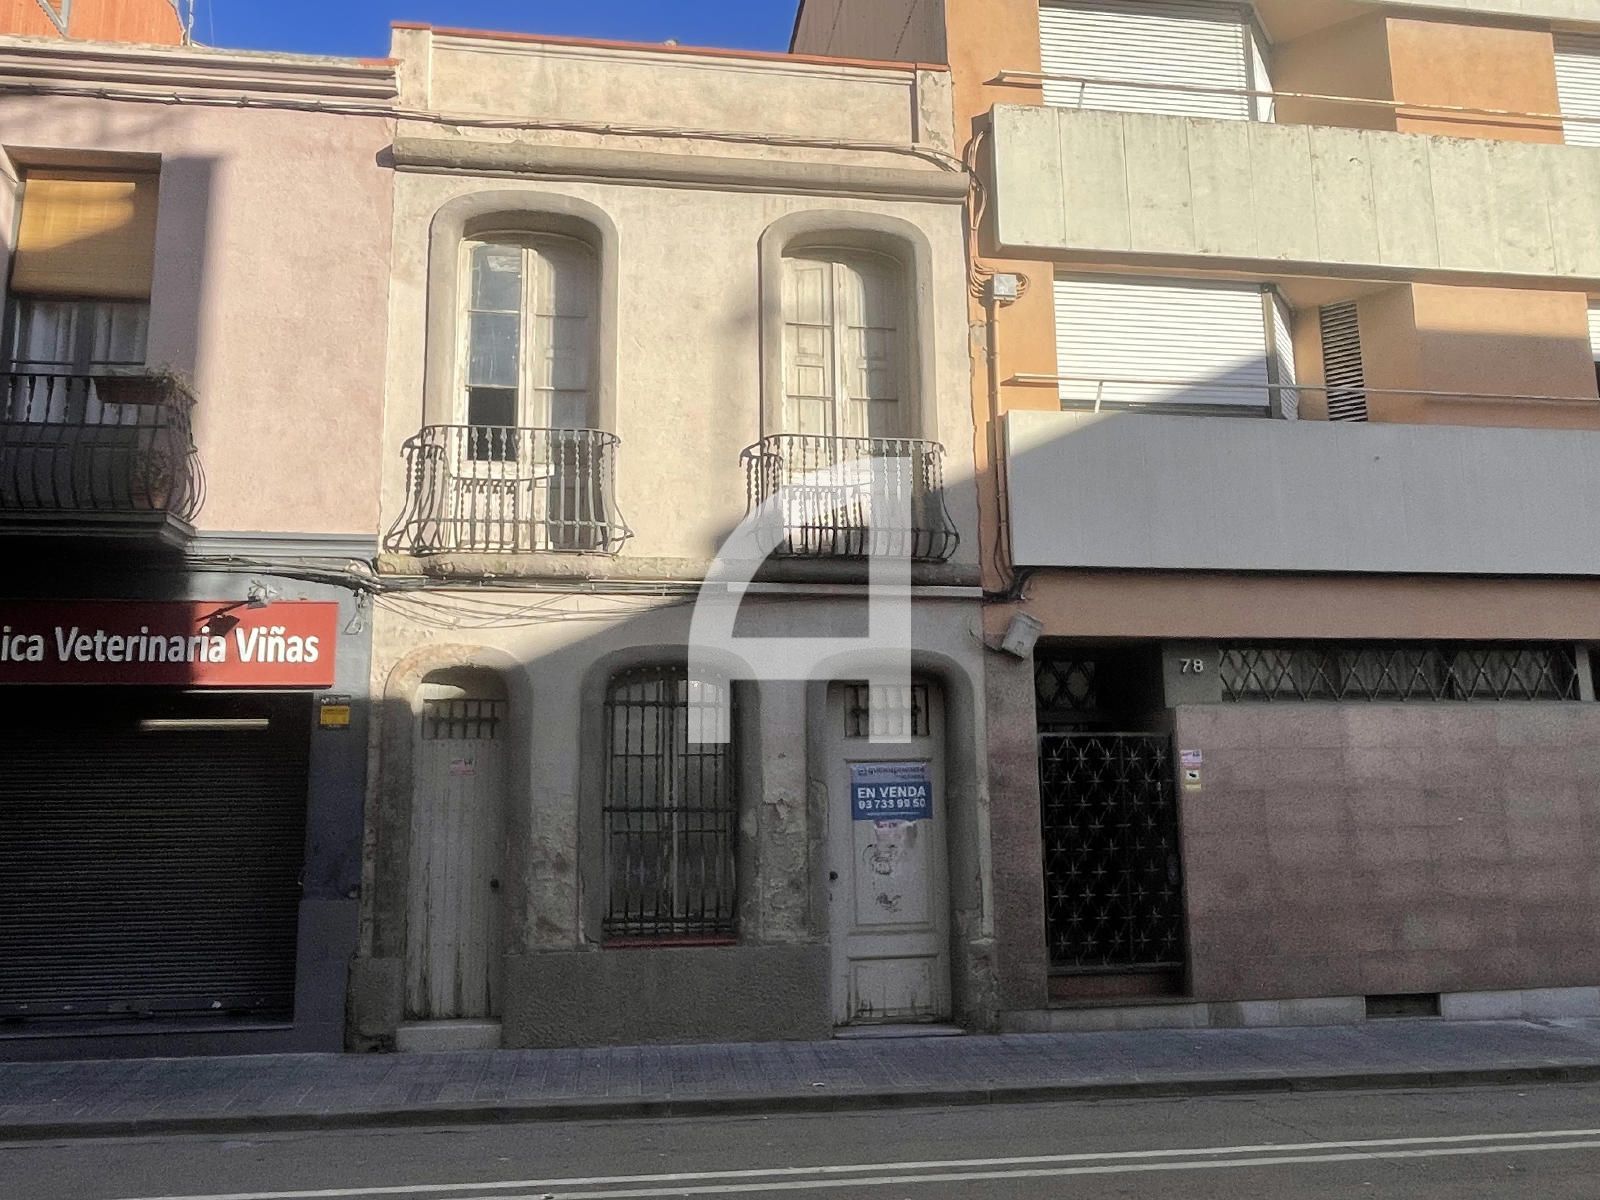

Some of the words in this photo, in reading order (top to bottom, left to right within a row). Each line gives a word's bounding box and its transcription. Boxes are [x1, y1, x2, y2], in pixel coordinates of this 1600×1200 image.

[1, 625, 44, 662] ica
[55, 626, 226, 662] Veterinaria
[235, 626, 319, 662] Viñas
[1180, 658, 1204, 673] 78
[857, 787, 876, 799] EN
[879, 786, 926, 798] VENDA
[875, 800, 895, 809] 733
[912, 798, 926, 807] 50
